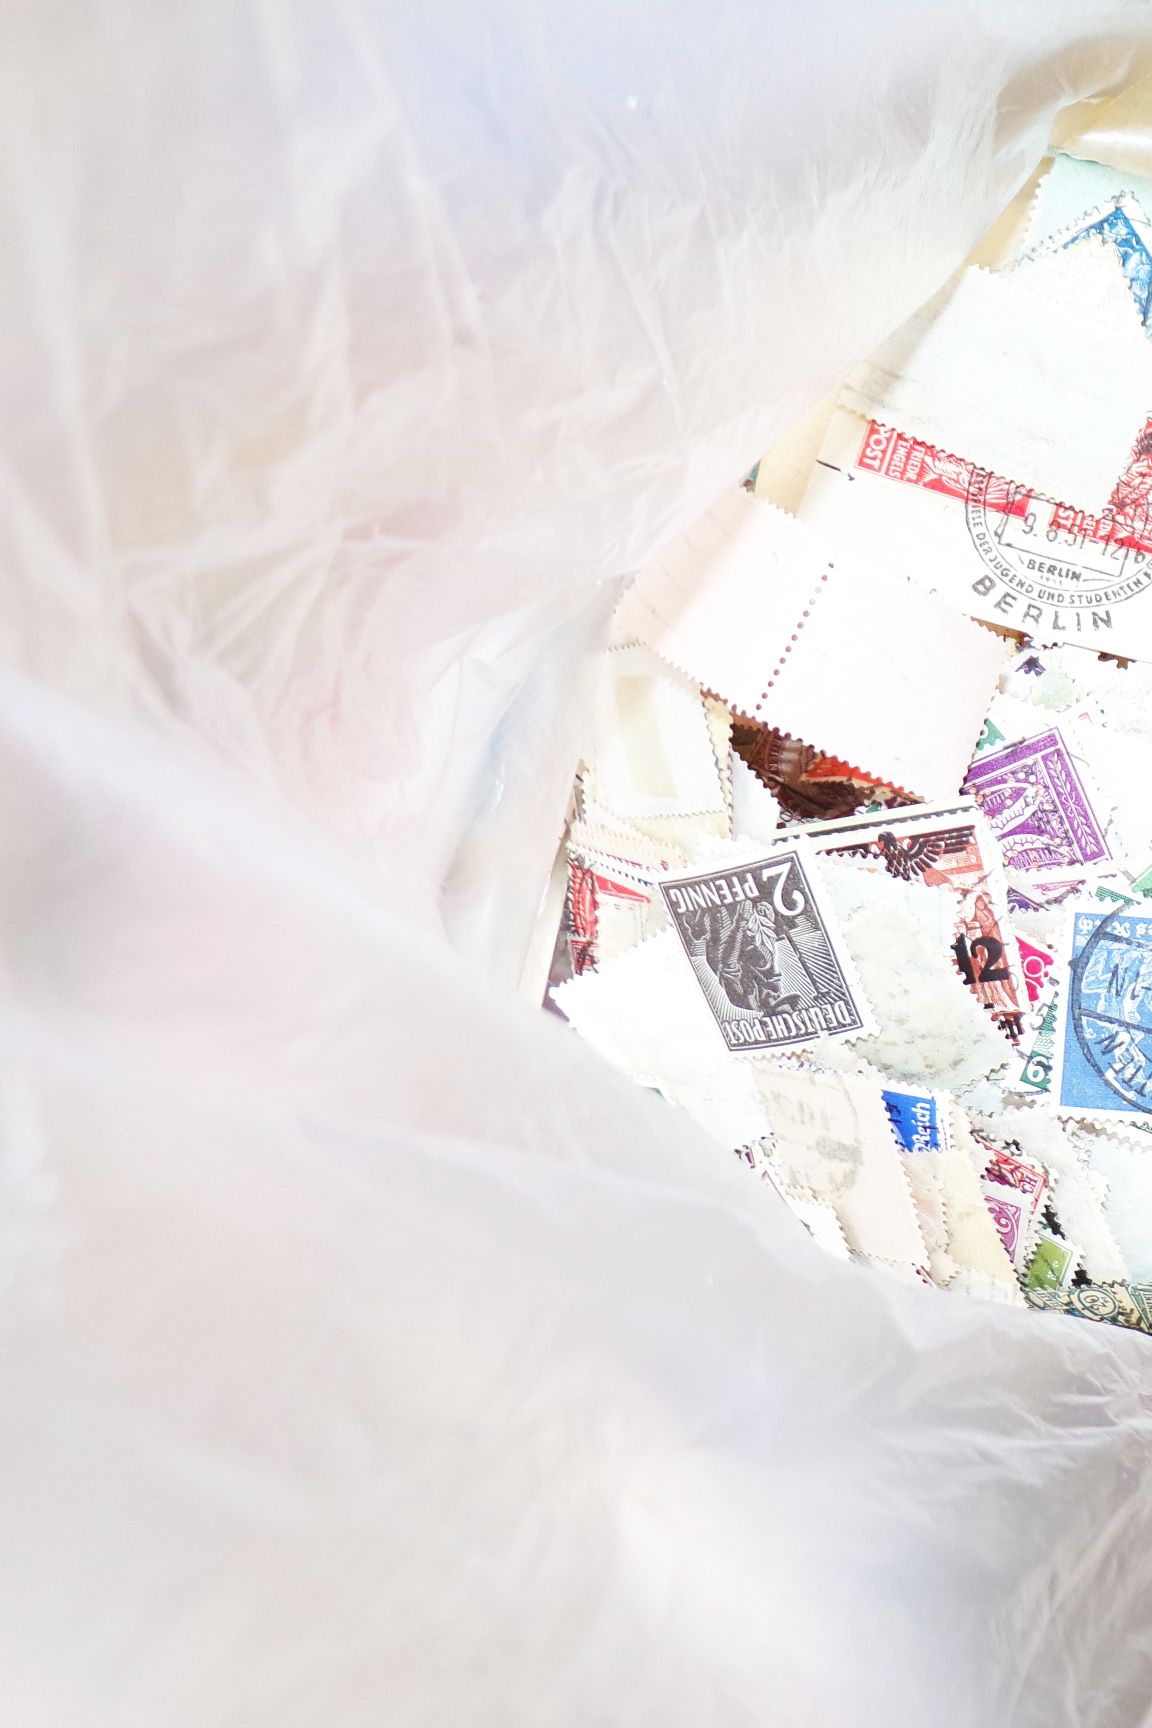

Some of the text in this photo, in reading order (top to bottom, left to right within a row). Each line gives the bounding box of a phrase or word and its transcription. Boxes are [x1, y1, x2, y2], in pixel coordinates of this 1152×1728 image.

[862, 423, 891, 471] POST
[887, 439, 912, 479] ENGELS
[975, 530, 994, 556] DER
[988, 553, 1035, 594] JUGEND
[1037, 588, 1065, 604] UND
[1068, 579, 1145, 606] STUDENTEN
[1026, 557, 1083, 583] BERLIN
[970, 572, 1114, 634] BERLIN
[670, 861, 806, 917] 2 PFENNIG
[723, 1000, 852, 1045] DEUTSCHE POST
